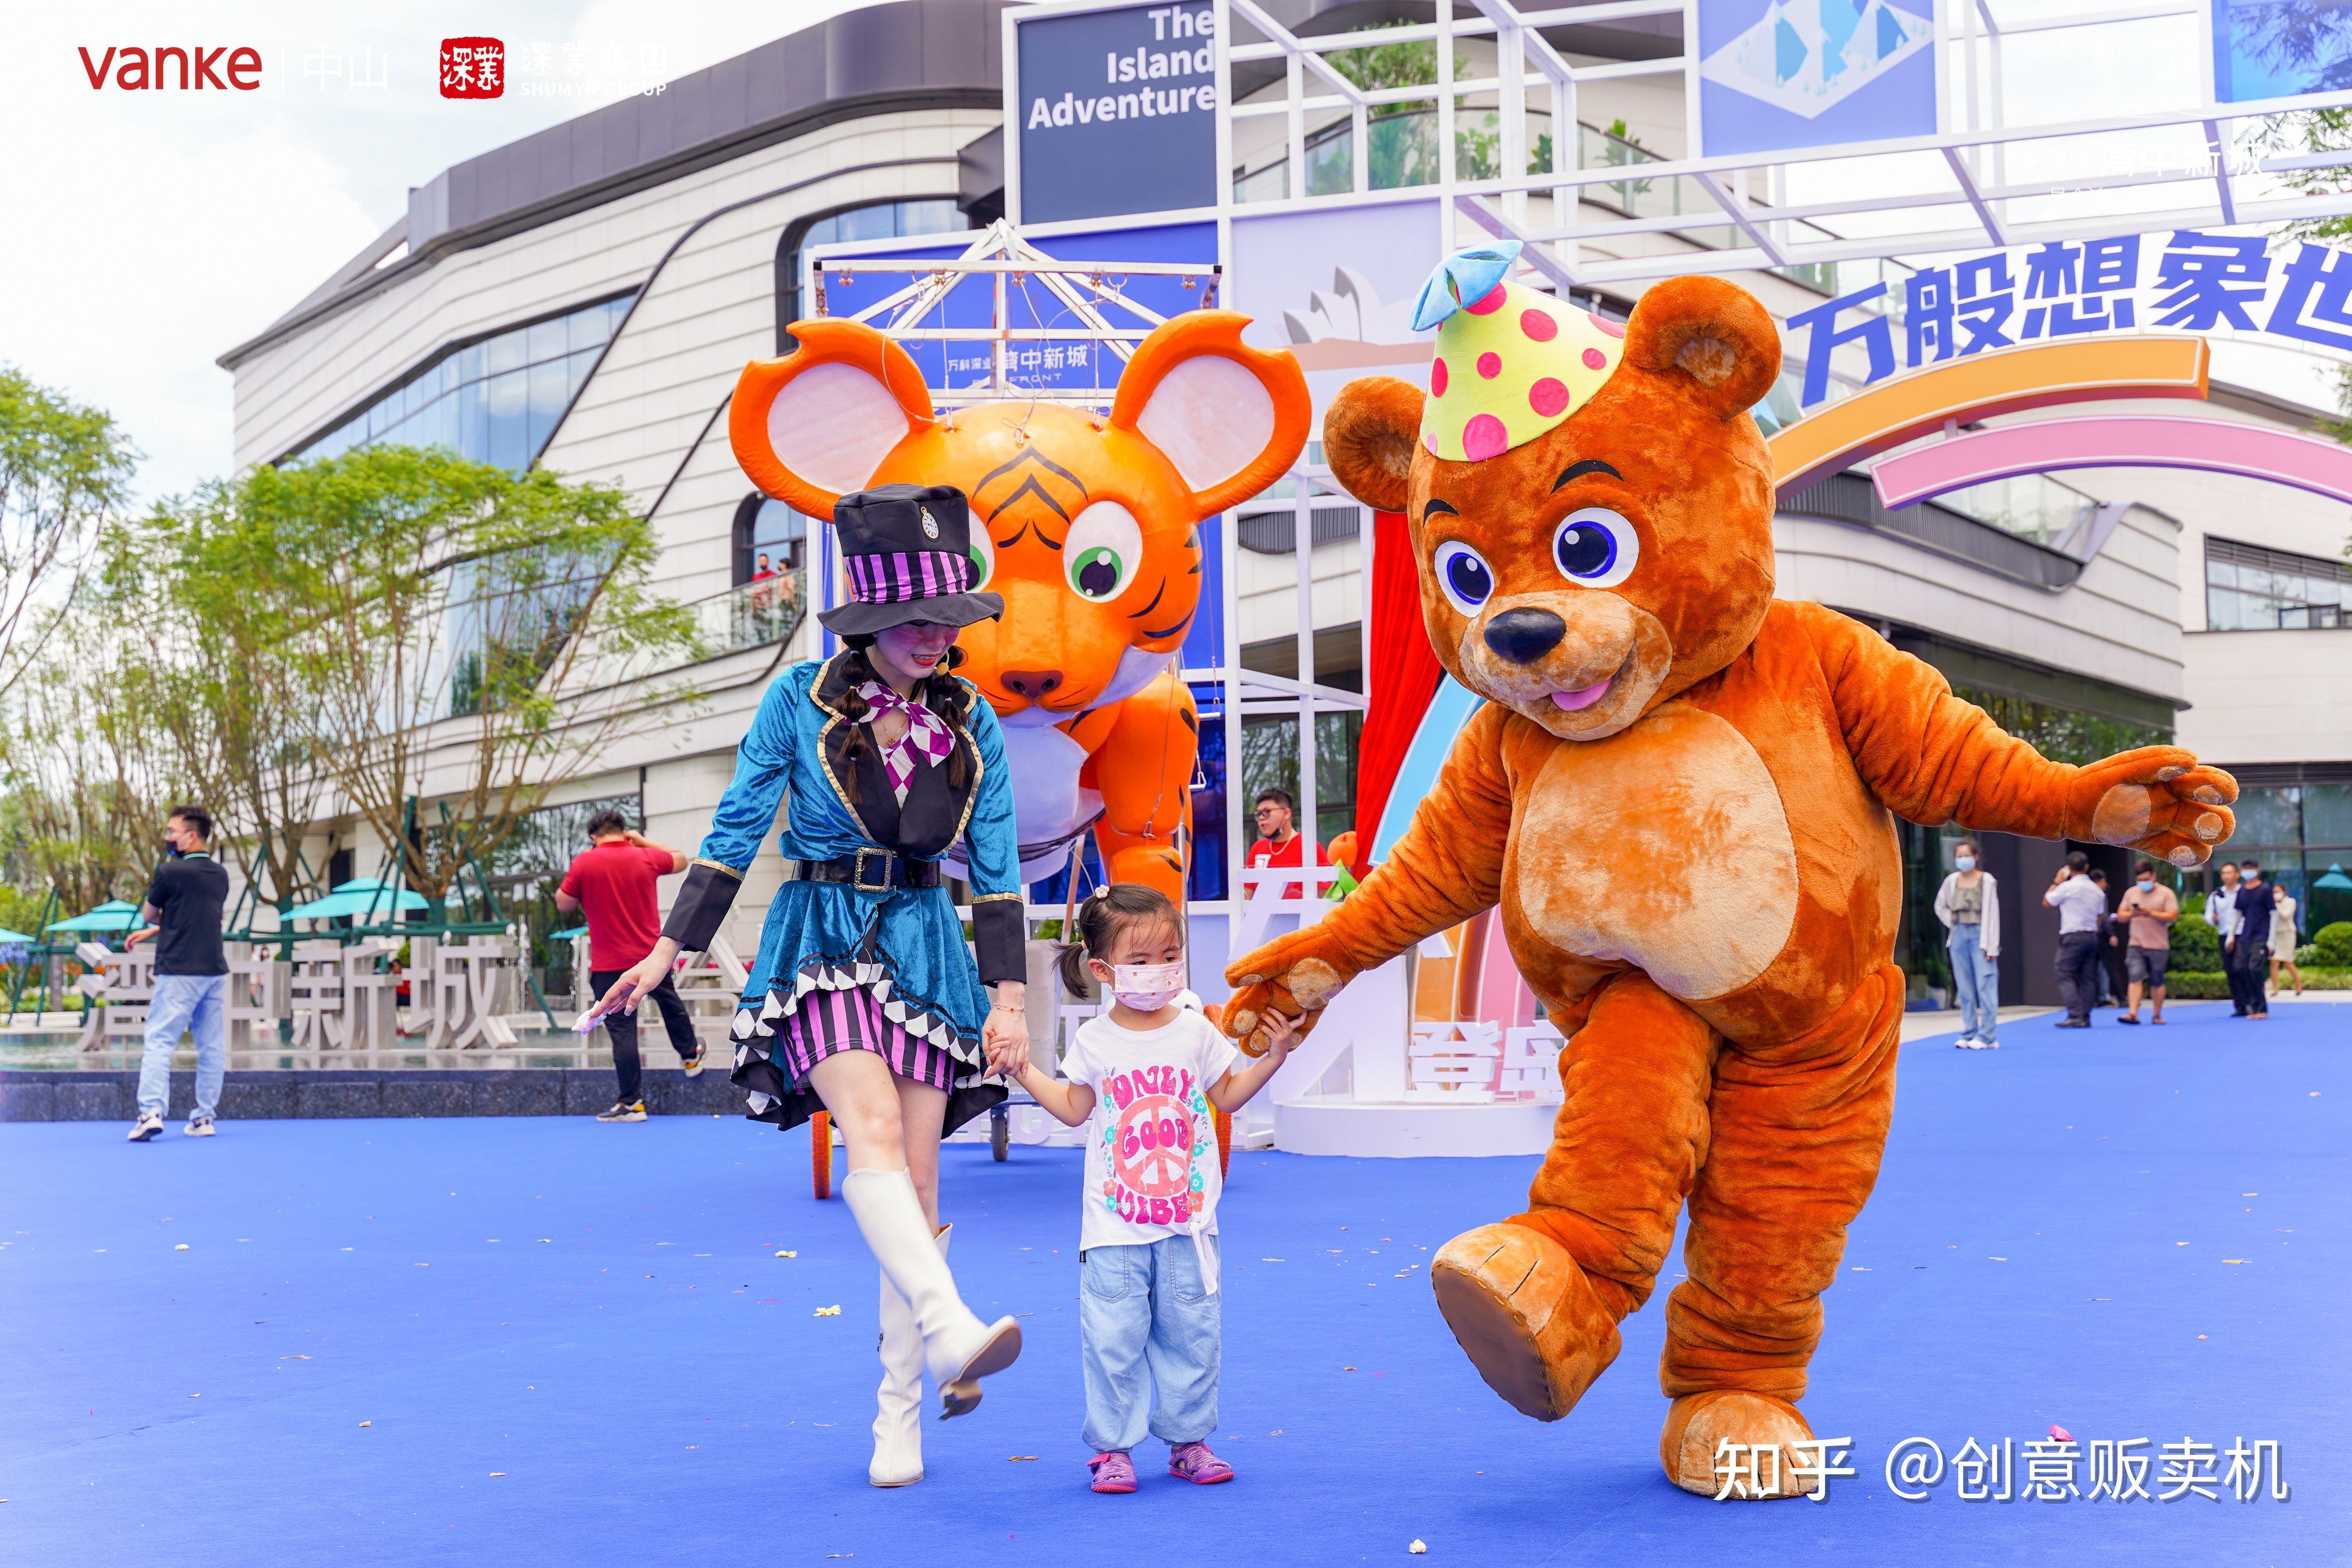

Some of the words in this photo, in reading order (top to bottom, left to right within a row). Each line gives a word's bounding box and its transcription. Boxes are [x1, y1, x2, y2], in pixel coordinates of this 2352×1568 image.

[1148, 6, 1214, 40] The
[1107, 39, 1215, 84] Island
[1027, 84, 1216, 130] Adventure
[1112, 1066, 1195, 1111] ONLY
[1123, 1118, 1189, 1159] GOOD
